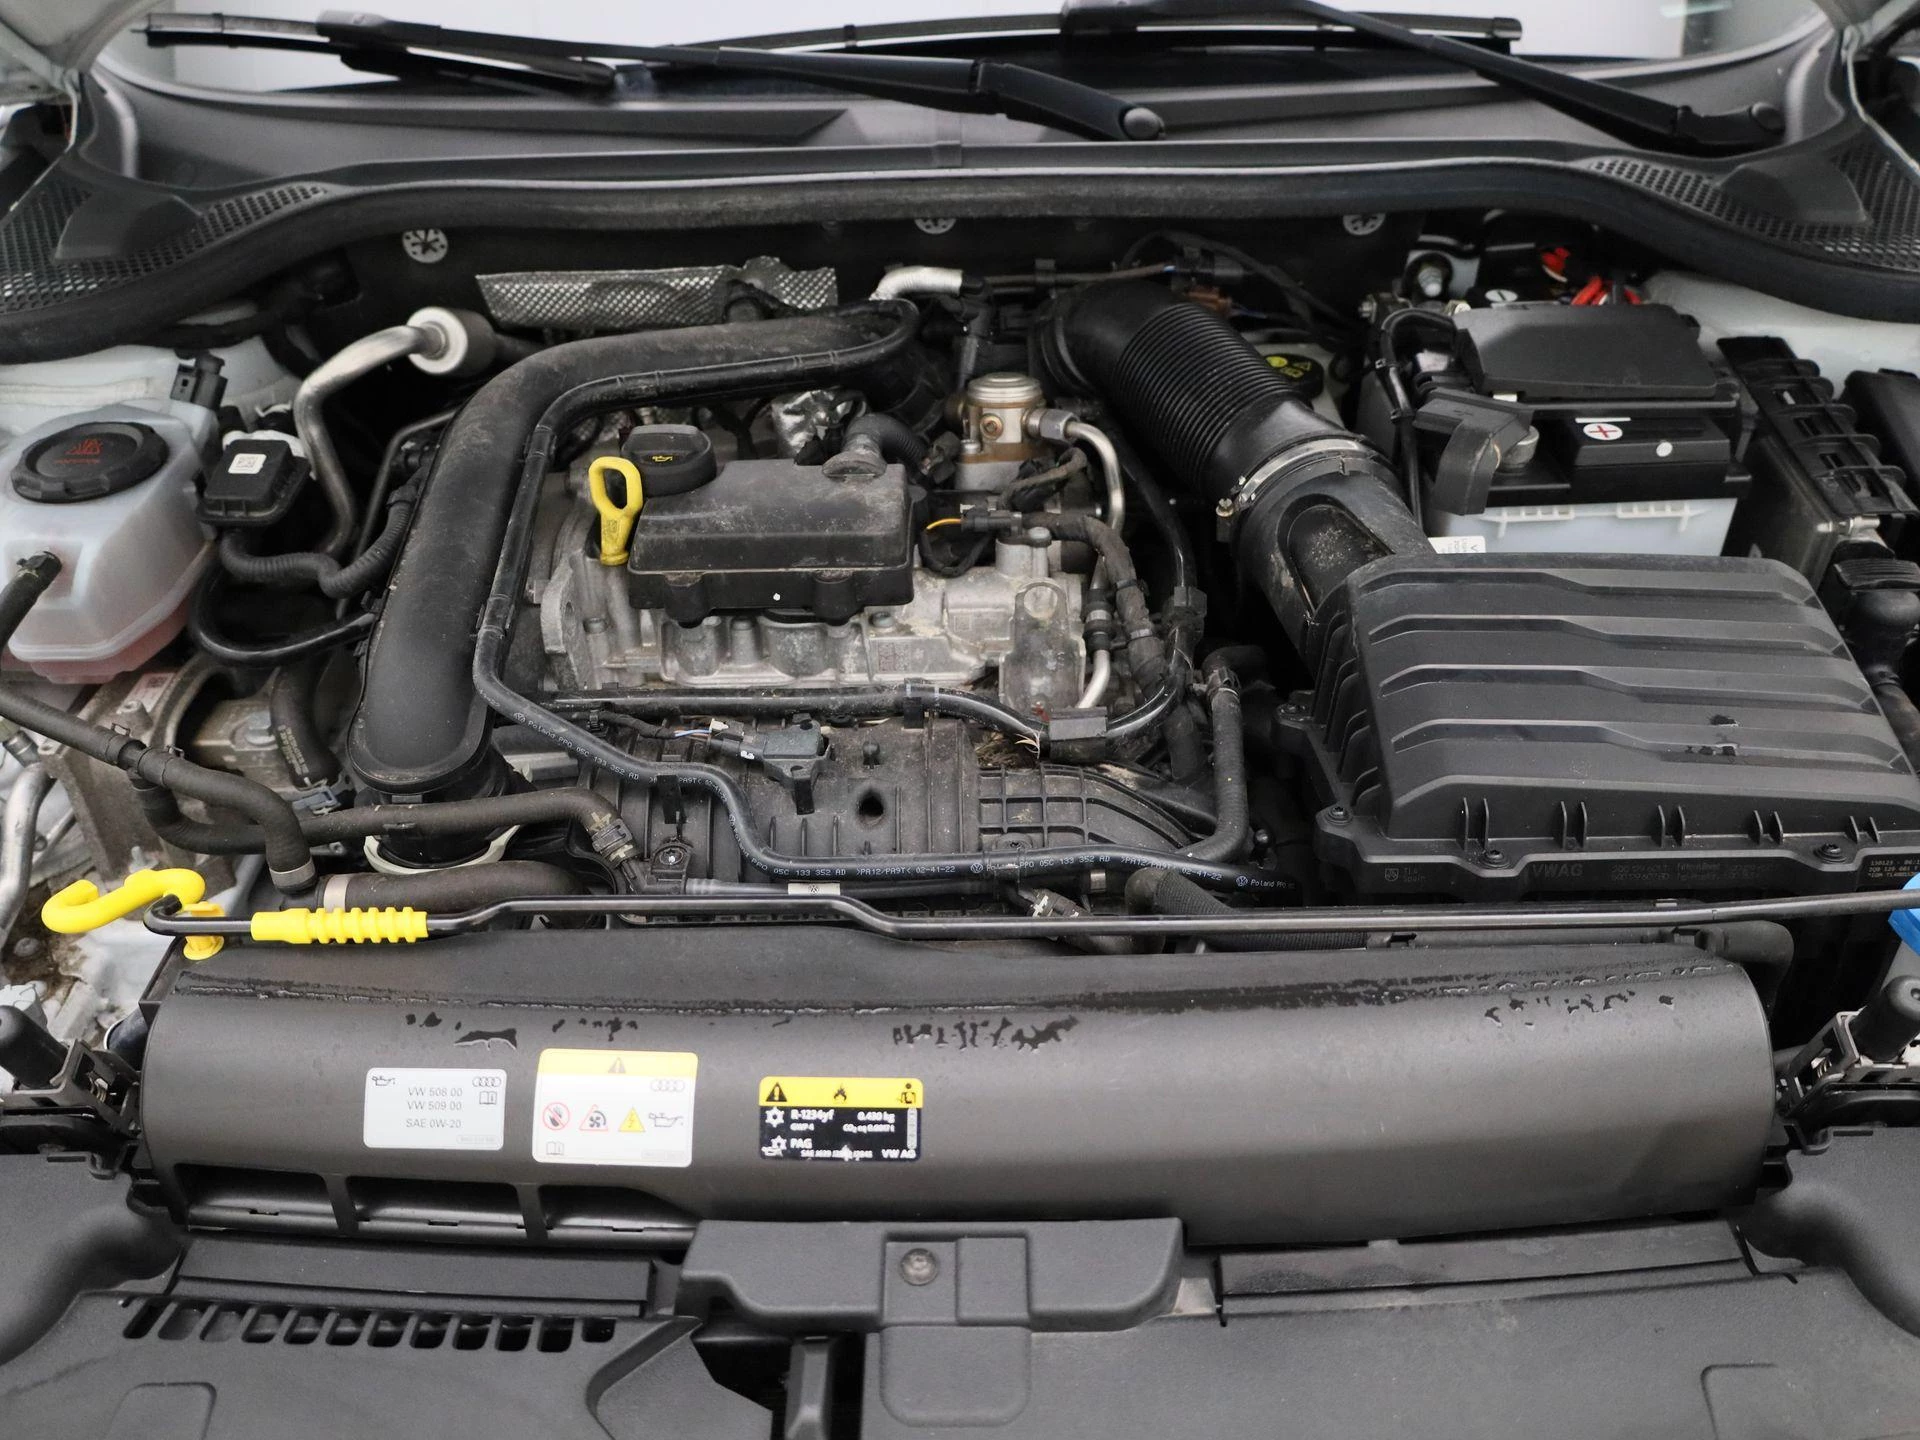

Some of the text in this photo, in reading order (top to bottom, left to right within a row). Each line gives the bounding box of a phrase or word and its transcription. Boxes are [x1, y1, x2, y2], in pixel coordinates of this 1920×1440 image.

[528, 720, 556, 739] Poland
[593, 756, 607, 767] 133
[610, 765, 625, 776] 352
[628, 772, 640, 780] AD
[751, 857, 768, 871] PPO
[773, 868, 790, 876] 05C
[815, 868, 831, 876] 352
[835, 868, 846, 876] AD
[915, 865, 956, 874] 02-41-22
[1019, 861, 1034, 869] PPO
[1039, 858, 1055, 867] 05C
[1060, 857, 1075, 865] 133
[1079, 855, 1094, 863] 352
[1181, 867, 1223, 881] 02-41-22
[1250, 878, 1275, 888] Poland
[408, 1087, 463, 1097] VW 508 00
[407, 1101, 462, 1111] VW 509 00
[790, 1109, 834, 1123] R-1234yf
[883, 1111, 896, 1123] kg
[406, 1118, 462, 1128] SAE 0W-20
[790, 1138, 813, 1149] PAG
[881, 1149, 916, 1158] VW AG
